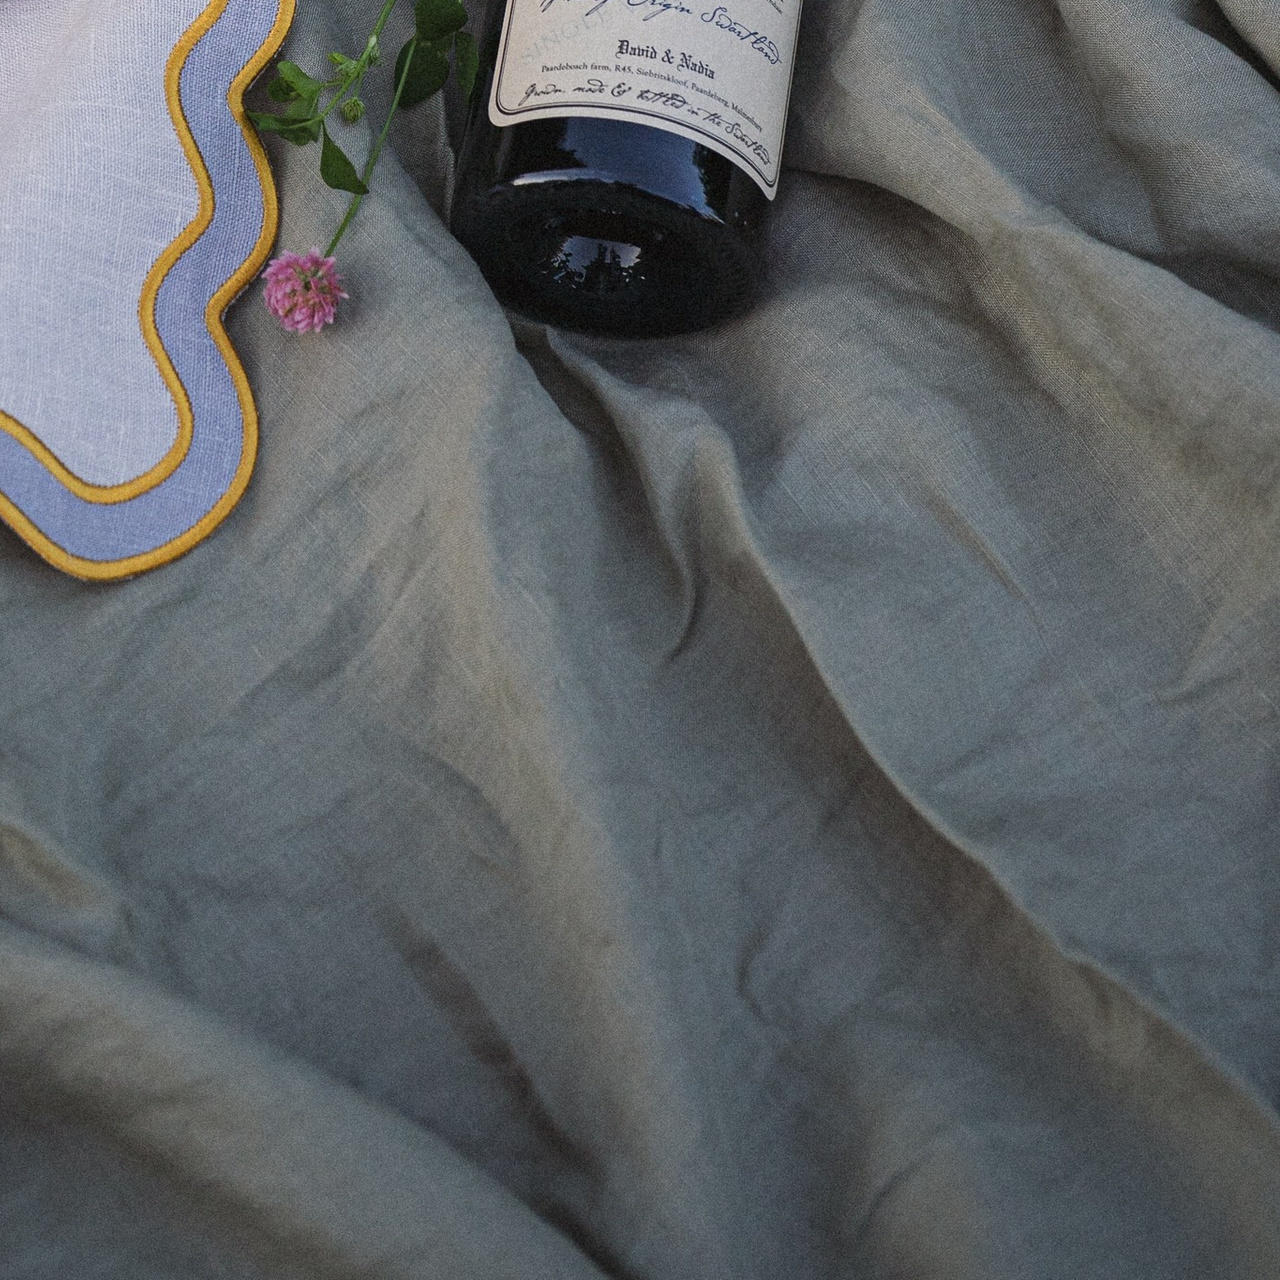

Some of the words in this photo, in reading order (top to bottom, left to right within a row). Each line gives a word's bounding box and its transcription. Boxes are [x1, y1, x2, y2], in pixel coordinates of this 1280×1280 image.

[701, 6, 783, 65] Swartland
[541, 62, 588, 73] Paardebosch
[590, 61, 612, 73] farm,
[614, 63, 634, 76] R45,
[615, 39, 658, 60] David
[661, 48, 675, 65] &
[676, 51, 716, 80] Nadia
[573, 78, 609, 95] made
